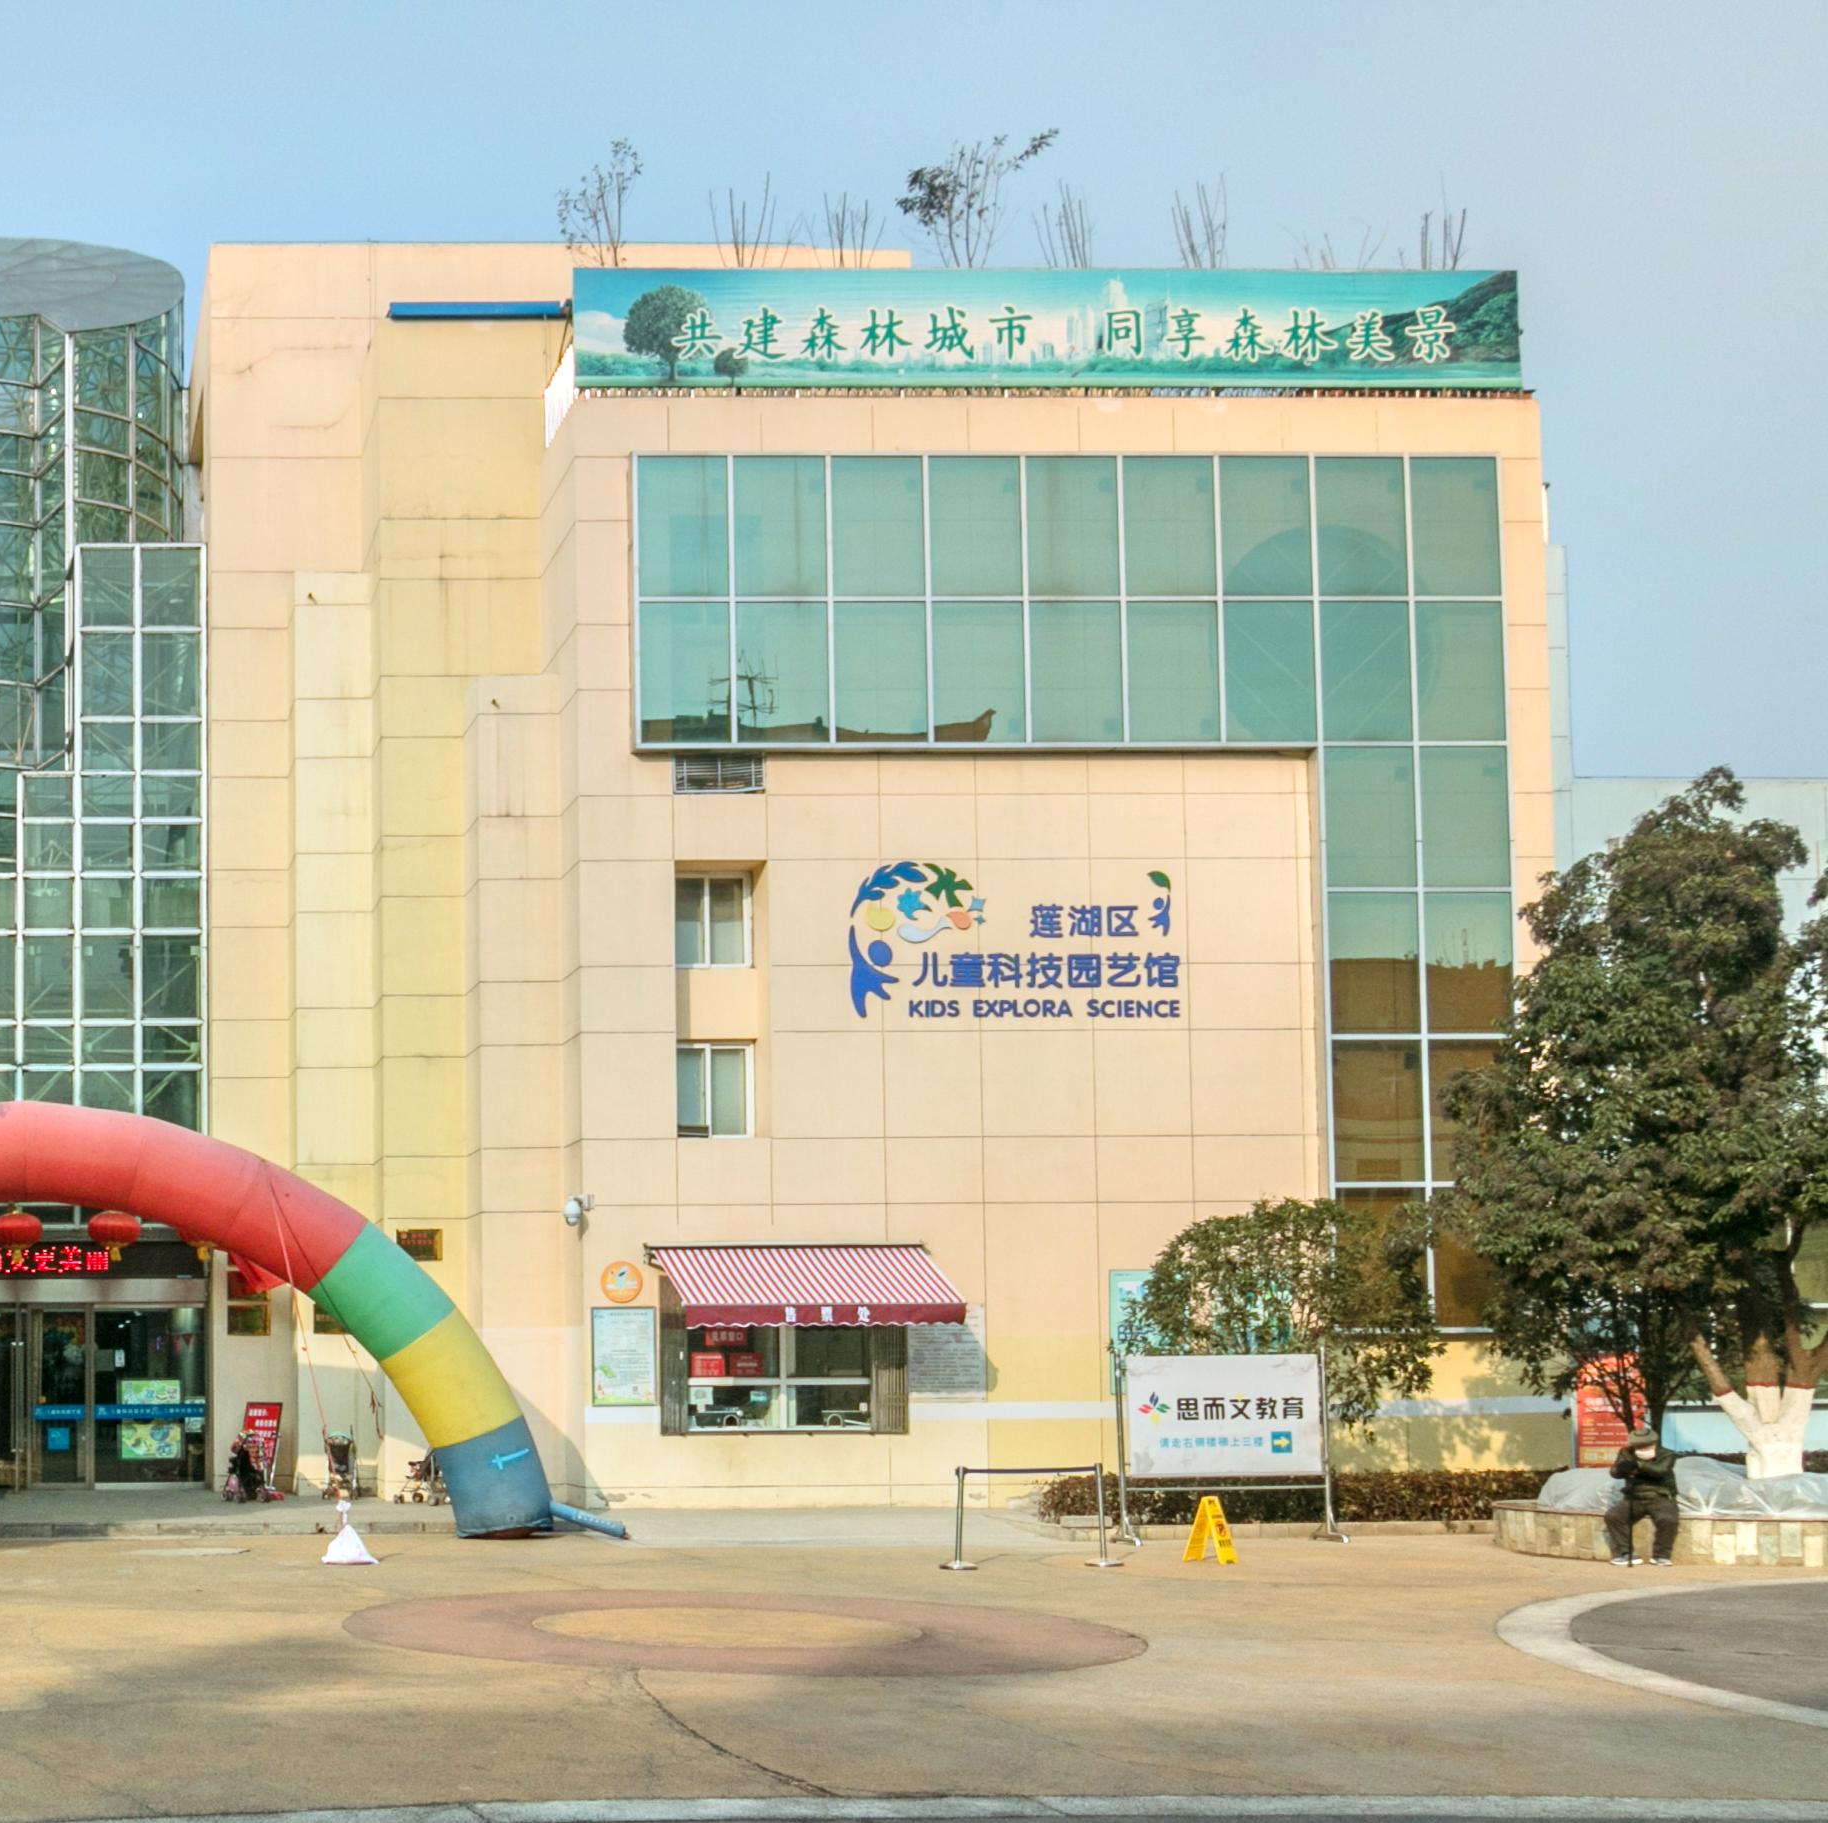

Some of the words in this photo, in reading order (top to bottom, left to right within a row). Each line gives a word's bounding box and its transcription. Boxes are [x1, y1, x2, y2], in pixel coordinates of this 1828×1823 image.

[673, 305, 1034, 360] 共建森林城市
[1105, 307, 1455, 360] 同享森林美景
[1029, 904, 1139, 938] 莲湖区
[912, 952, 1180, 989] 儿童科技园艺馆
[909, 999, 960, 1018] KIDS
[973, 999, 1073, 1018] EXPLORA
[1087, 999, 1180, 1018] SCIENCE
[785, 1306, 870, 1323] 售票处
[1177, 1396, 1304, 1421] 思而文教育
